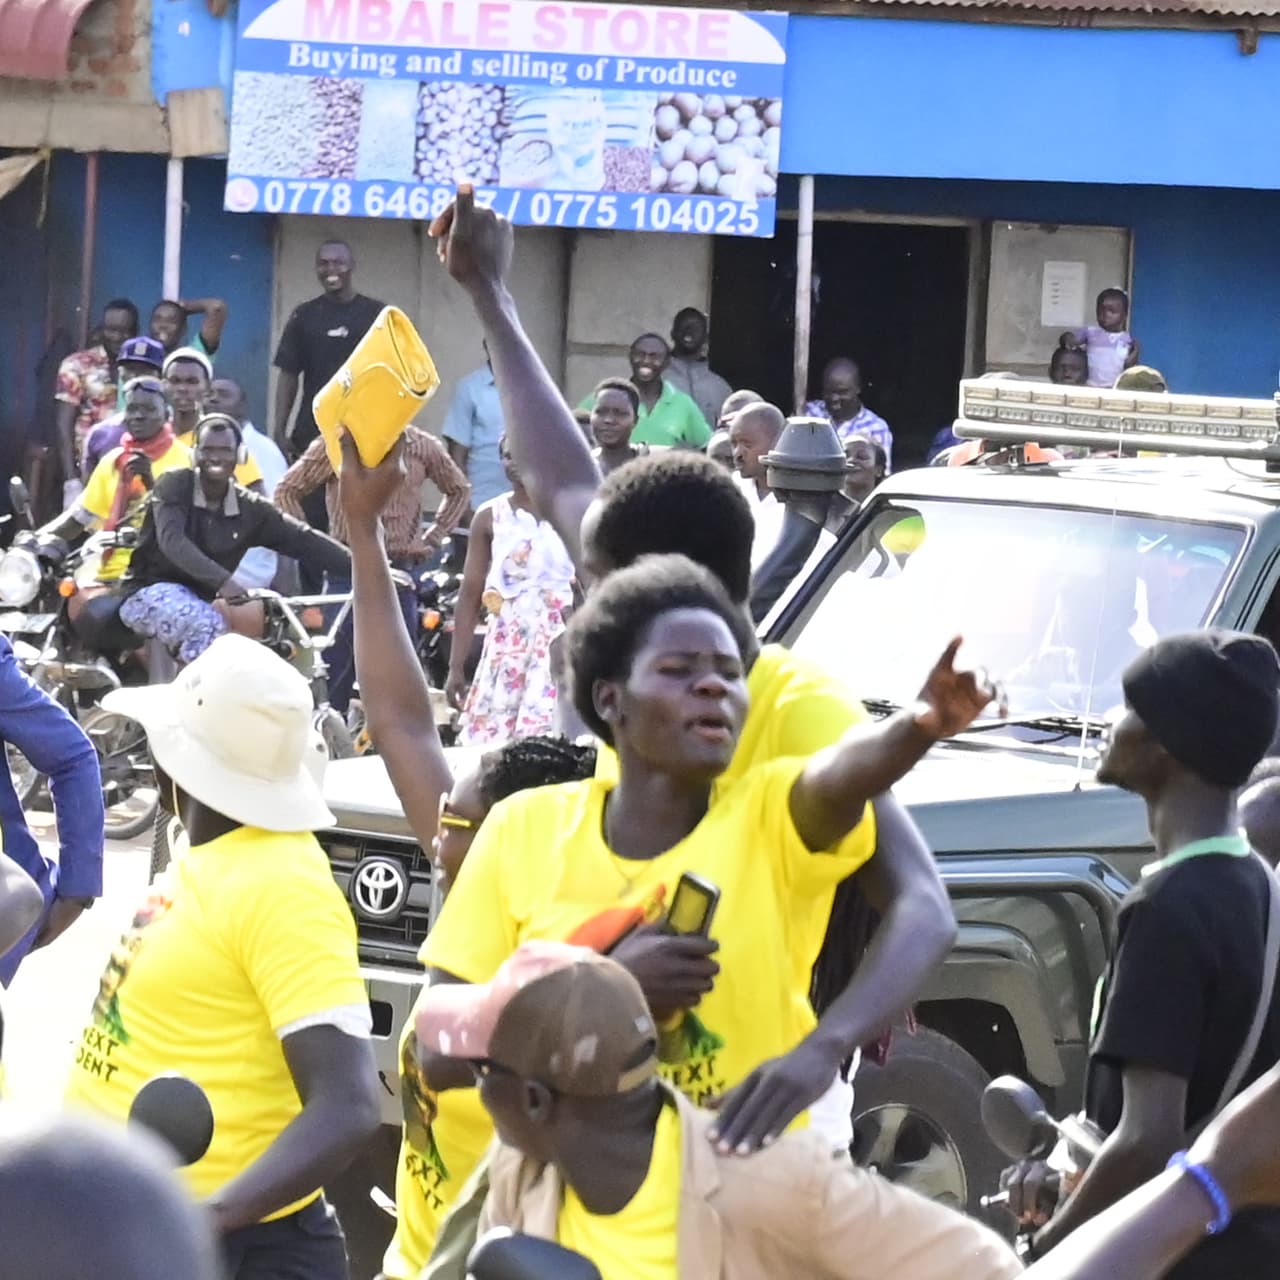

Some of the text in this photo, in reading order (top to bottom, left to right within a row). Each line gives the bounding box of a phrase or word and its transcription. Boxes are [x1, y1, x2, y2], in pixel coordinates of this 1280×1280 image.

[532, 5, 730, 58] STORE
[288, 42, 737, 88] Buying and selling of Produce
[263, 180, 352, 216] 0778
[363, 184, 497, 220] 64687
[529, 193, 618, 227] 0775
[629, 198, 760, 233] 104025
